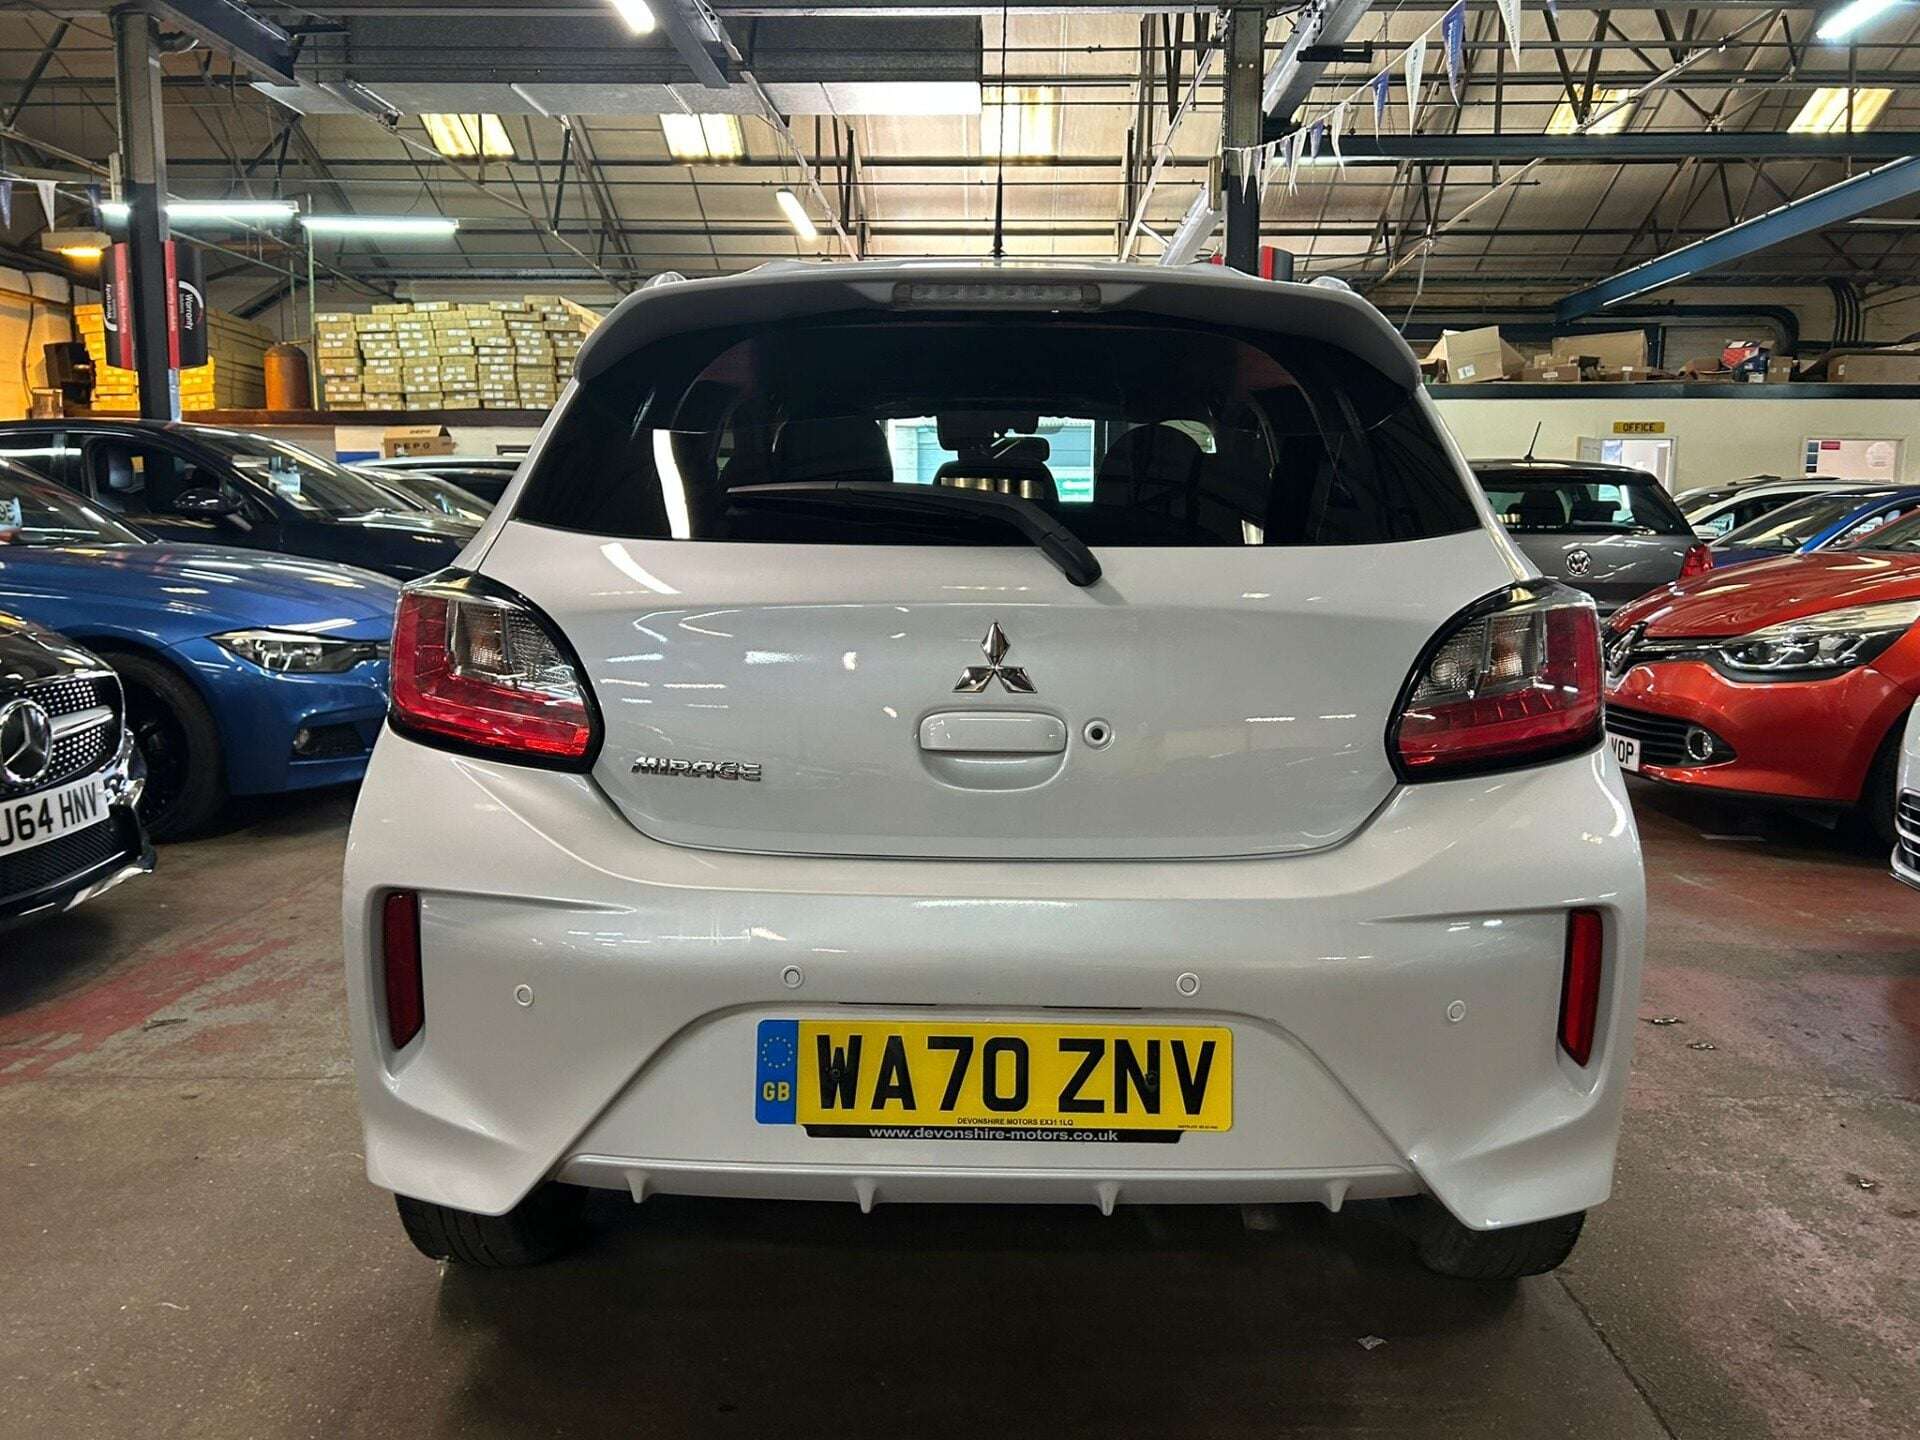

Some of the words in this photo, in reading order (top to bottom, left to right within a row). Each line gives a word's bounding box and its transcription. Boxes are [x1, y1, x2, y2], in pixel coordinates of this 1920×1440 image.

[184, 294, 194, 330] Warranty
[1622, 422, 1655, 433] OFFICE
[631, 756, 761, 781] MIRAGE
[59, 782, 97, 828] HNV
[816, 1034, 1029, 1112] WA70
[1057, 1037, 1217, 1115] ZNV
[763, 1081, 790, 1101] GB
[957, 1117, 1005, 1126] DEVONSHIRE
[1007, 1117, 1038, 1126] MOTORS
[869, 1128, 1118, 1141] www.devonshire-motors.co.uk
